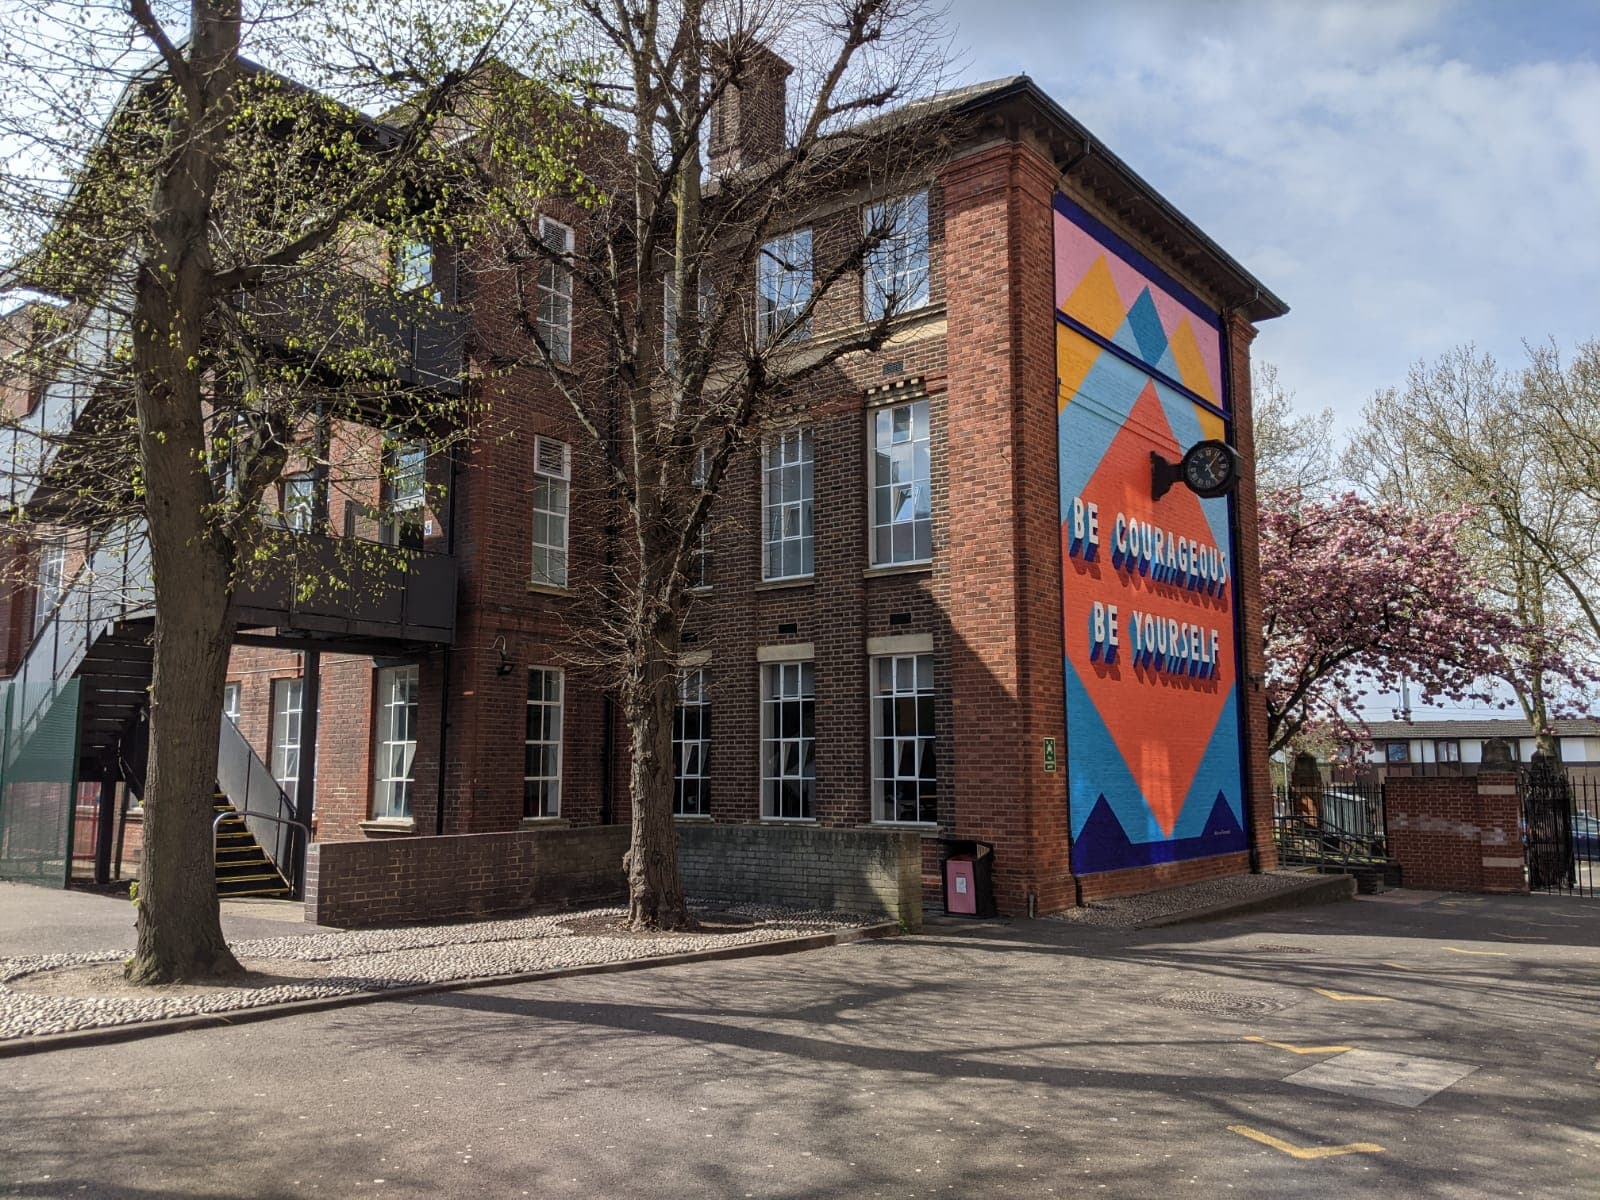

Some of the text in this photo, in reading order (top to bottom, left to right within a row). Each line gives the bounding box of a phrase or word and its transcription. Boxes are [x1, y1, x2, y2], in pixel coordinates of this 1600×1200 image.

[1072, 496, 1226, 586] BE COURAGEOUS
[1092, 600, 1219, 666] BE YOURSELF
